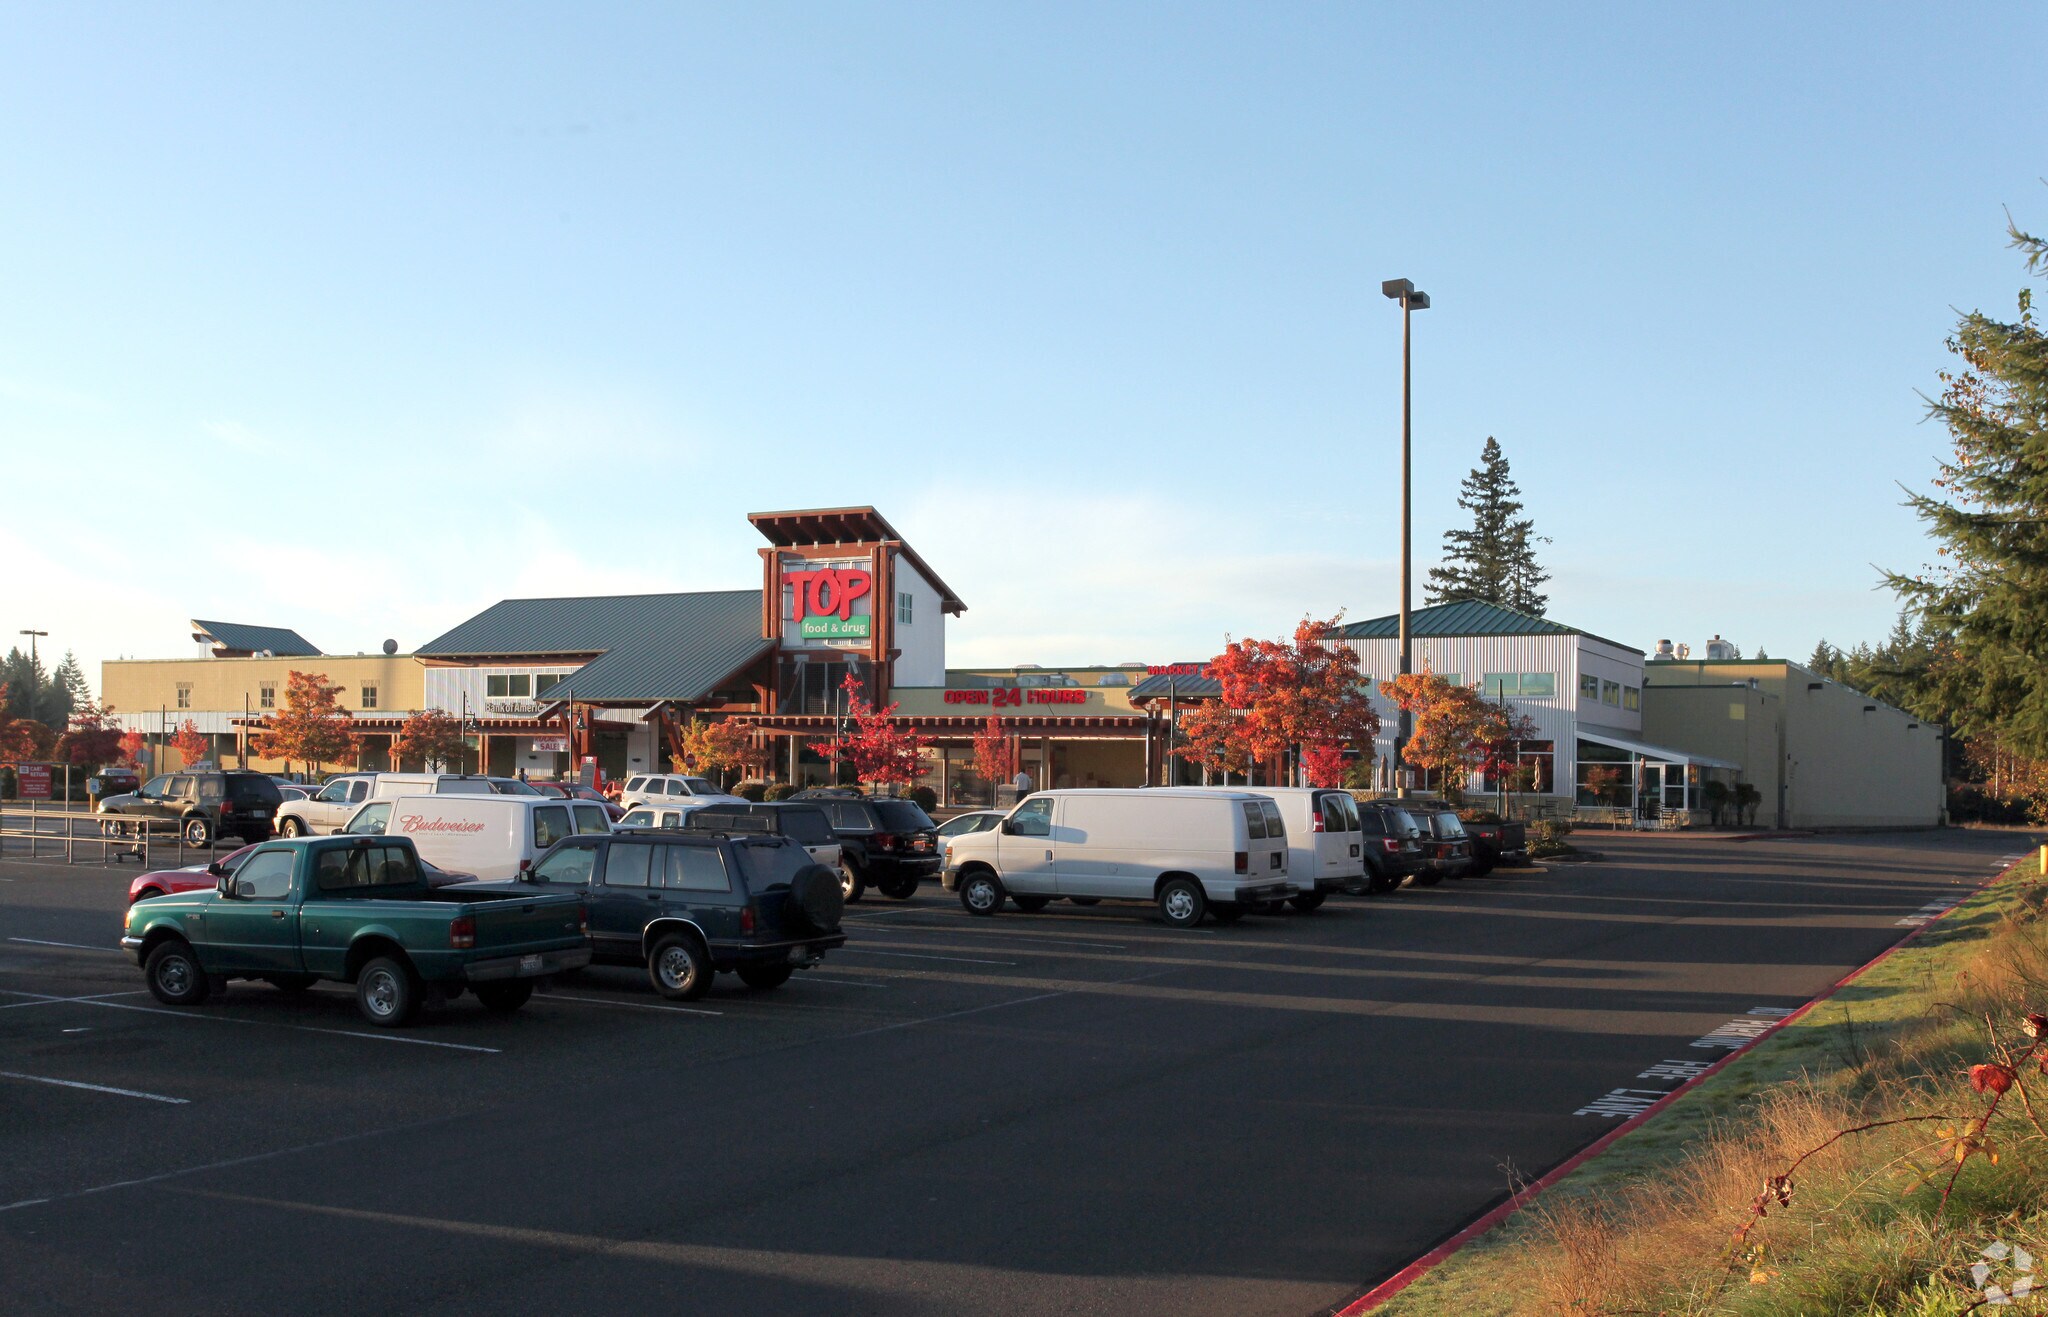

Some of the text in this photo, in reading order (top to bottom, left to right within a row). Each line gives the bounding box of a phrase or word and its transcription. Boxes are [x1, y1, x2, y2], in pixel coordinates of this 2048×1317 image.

[782, 568, 871, 623] TOP
[805, 622, 866, 635] food & drug
[1147, 665, 1198, 675] MARKET
[944, 687, 1086, 707] OPEN 24 HOURS
[400, 815, 485, 833] Budweiser
[1637, 1059, 1717, 1082] FIRE
[1572, 1088, 1673, 1120] LANE
